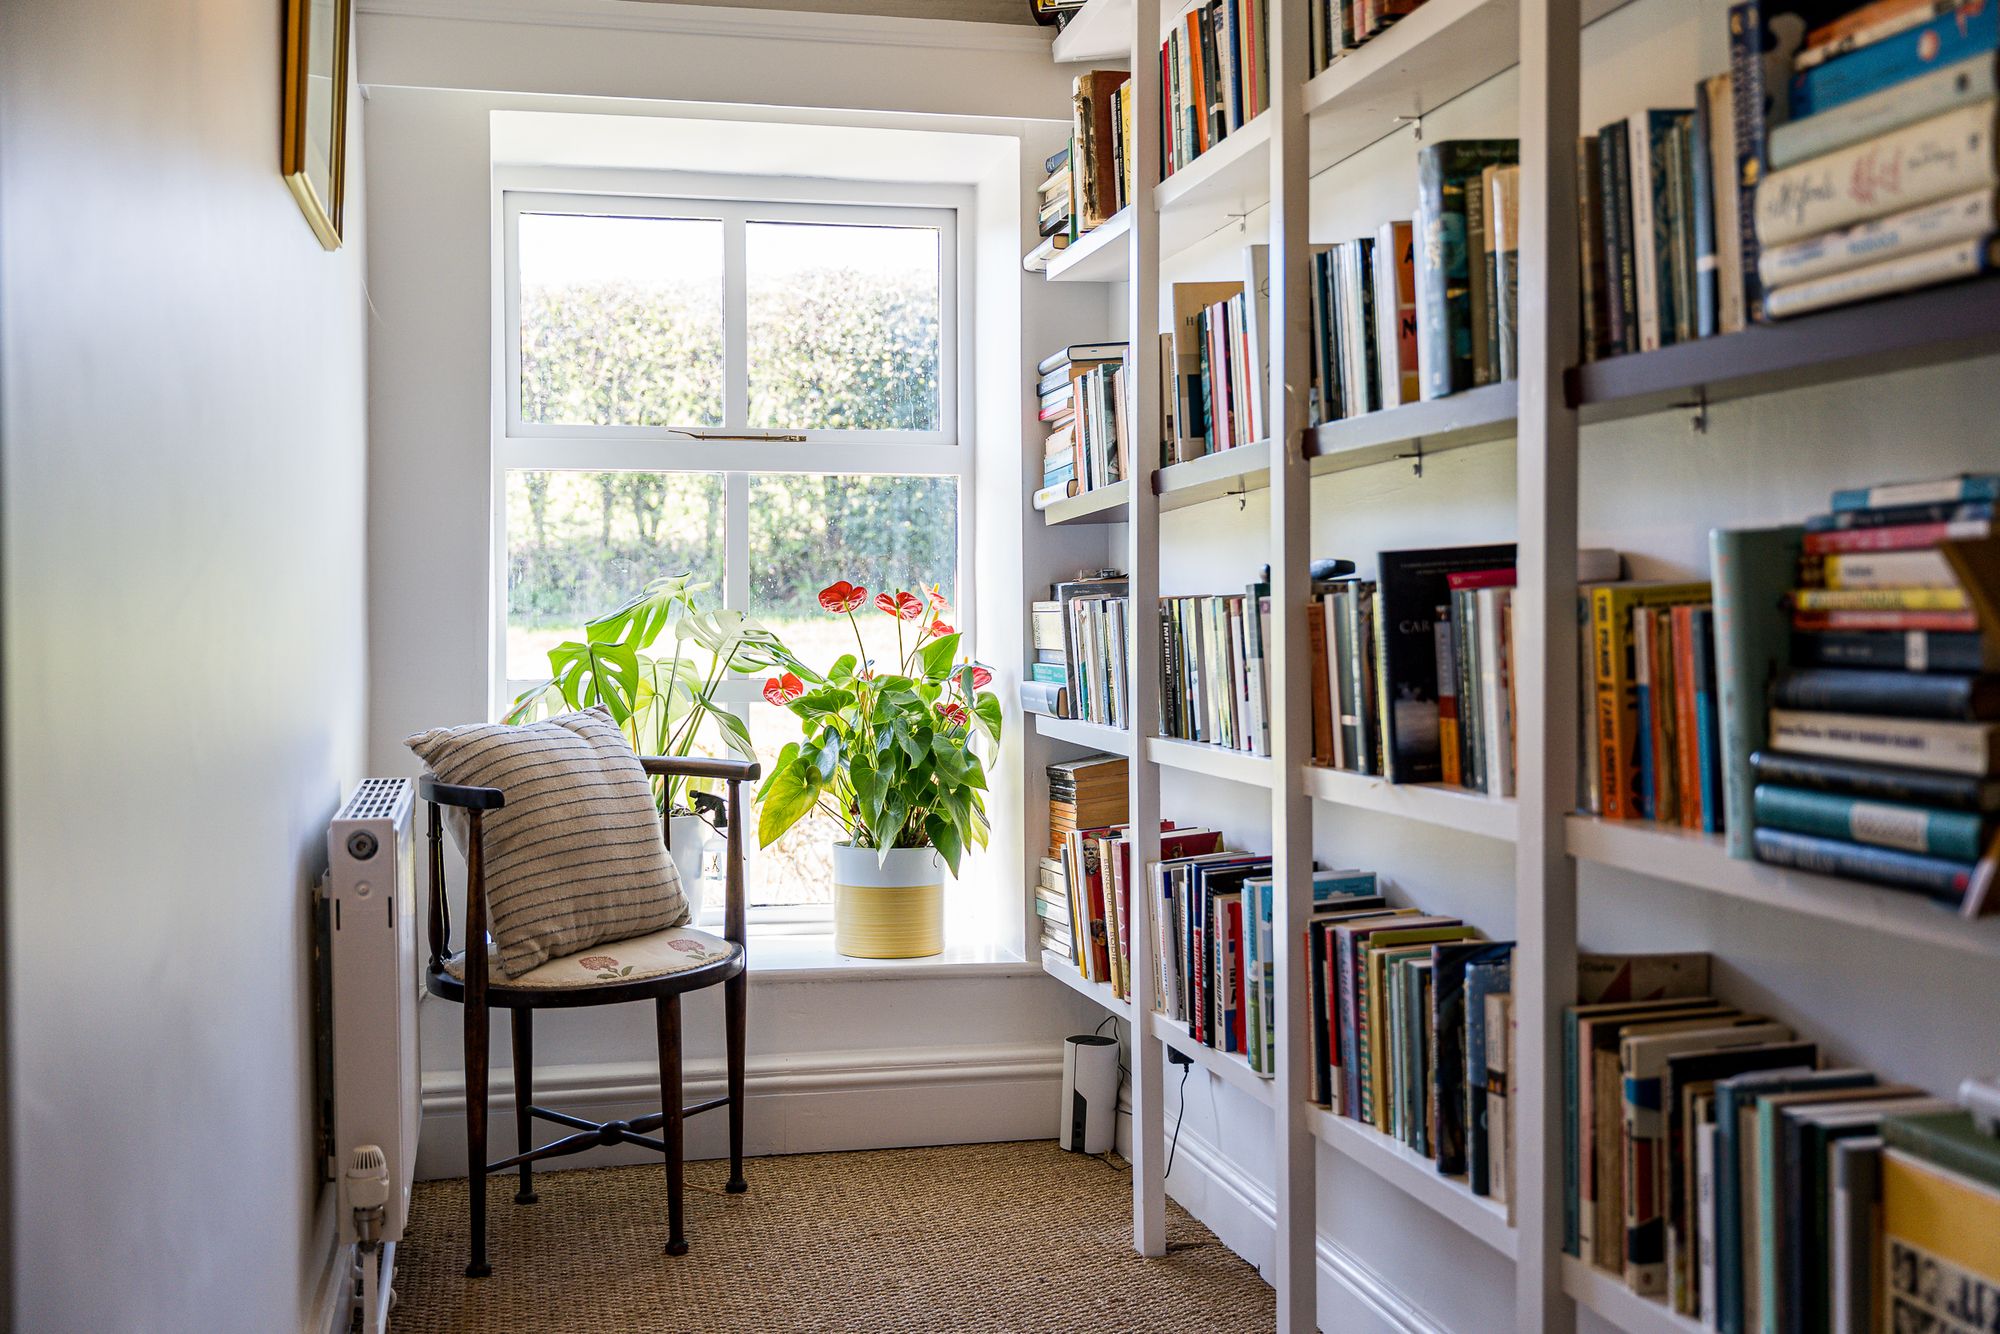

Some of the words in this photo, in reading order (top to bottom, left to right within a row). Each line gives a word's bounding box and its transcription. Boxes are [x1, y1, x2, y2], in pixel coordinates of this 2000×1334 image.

[1162, 622, 1172, 674] IMPERIUM
[1399, 619, 1431, 635] CAR
[1604, 746, 1617, 797] SMITH
[1106, 892, 1112, 905] UP
[1109, 931, 1117, 968] BODIES
